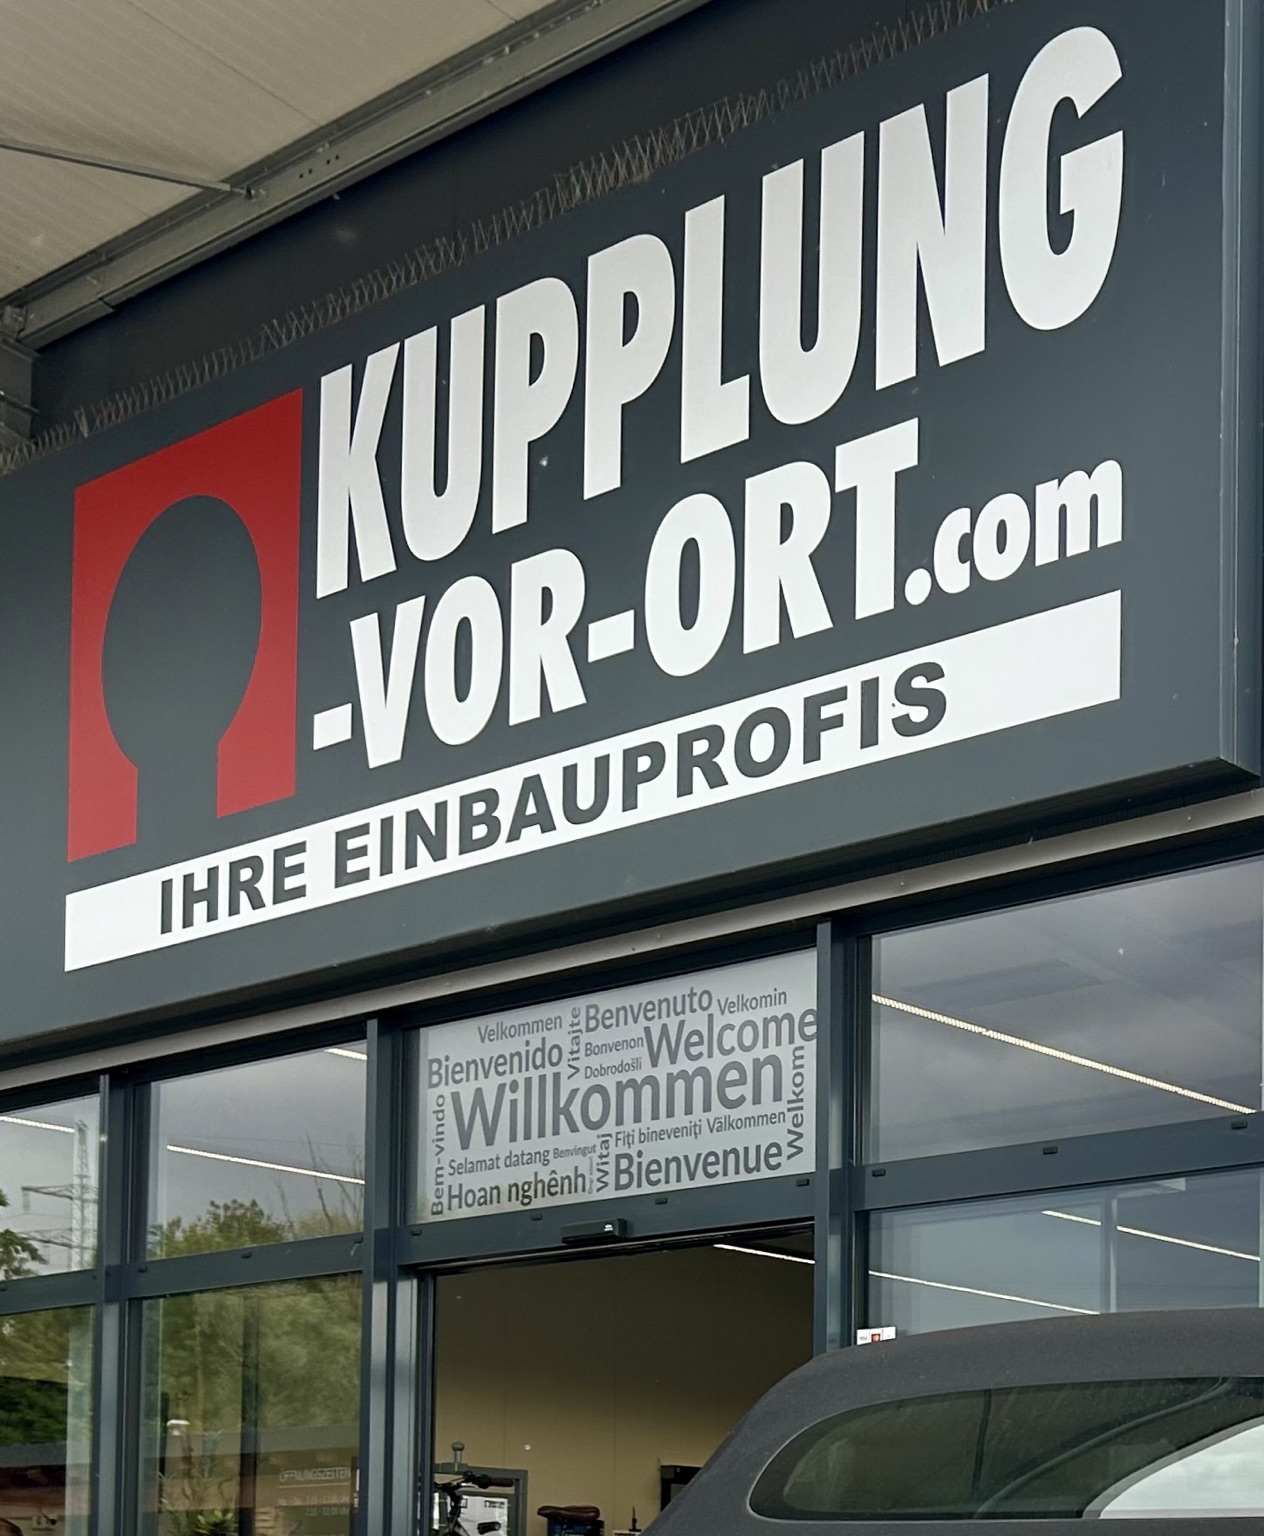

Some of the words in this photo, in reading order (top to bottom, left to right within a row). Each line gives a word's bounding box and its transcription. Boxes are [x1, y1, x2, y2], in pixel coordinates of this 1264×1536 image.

[316, 25, 1123, 599] KUPPLUNG
[312, 417, 1123, 769] -VOR-ORT.com
[160, 840, 307, 935] IHRE
[333, 661, 947, 888] EINBAUPROFIS
[585, 986, 713, 1033] Benvenuto
[717, 987, 787, 1016] Velkomin
[477, 1015, 563, 1044] Velkommen
[567, 1006, 583, 1080] Vitajte
[584, 1036, 644, 1057] Bonvenon
[643, 1008, 818, 1069] Welcome
[427, 1036, 563, 1089] Bienvenido
[584, 1057, 642, 1080] Dobrodošli
[450, 1053, 783, 1151] Willkommen
[706, 1110, 786, 1134] Välkommen
[786, 1045, 805, 1161] Welkom
[431, 1094, 446, 1216] Bem-vindo
[448, 1154, 500, 1177] Selamat
[504, 1149, 550, 1168] datang
[552, 1143, 597, 1160] Benvingut
[595, 1132, 612, 1193] Witaj
[614, 1141, 783, 1191] Bienvenue
[447, 1182, 501, 1211] Hoan
[507, 1165, 587, 1207] nghênh
